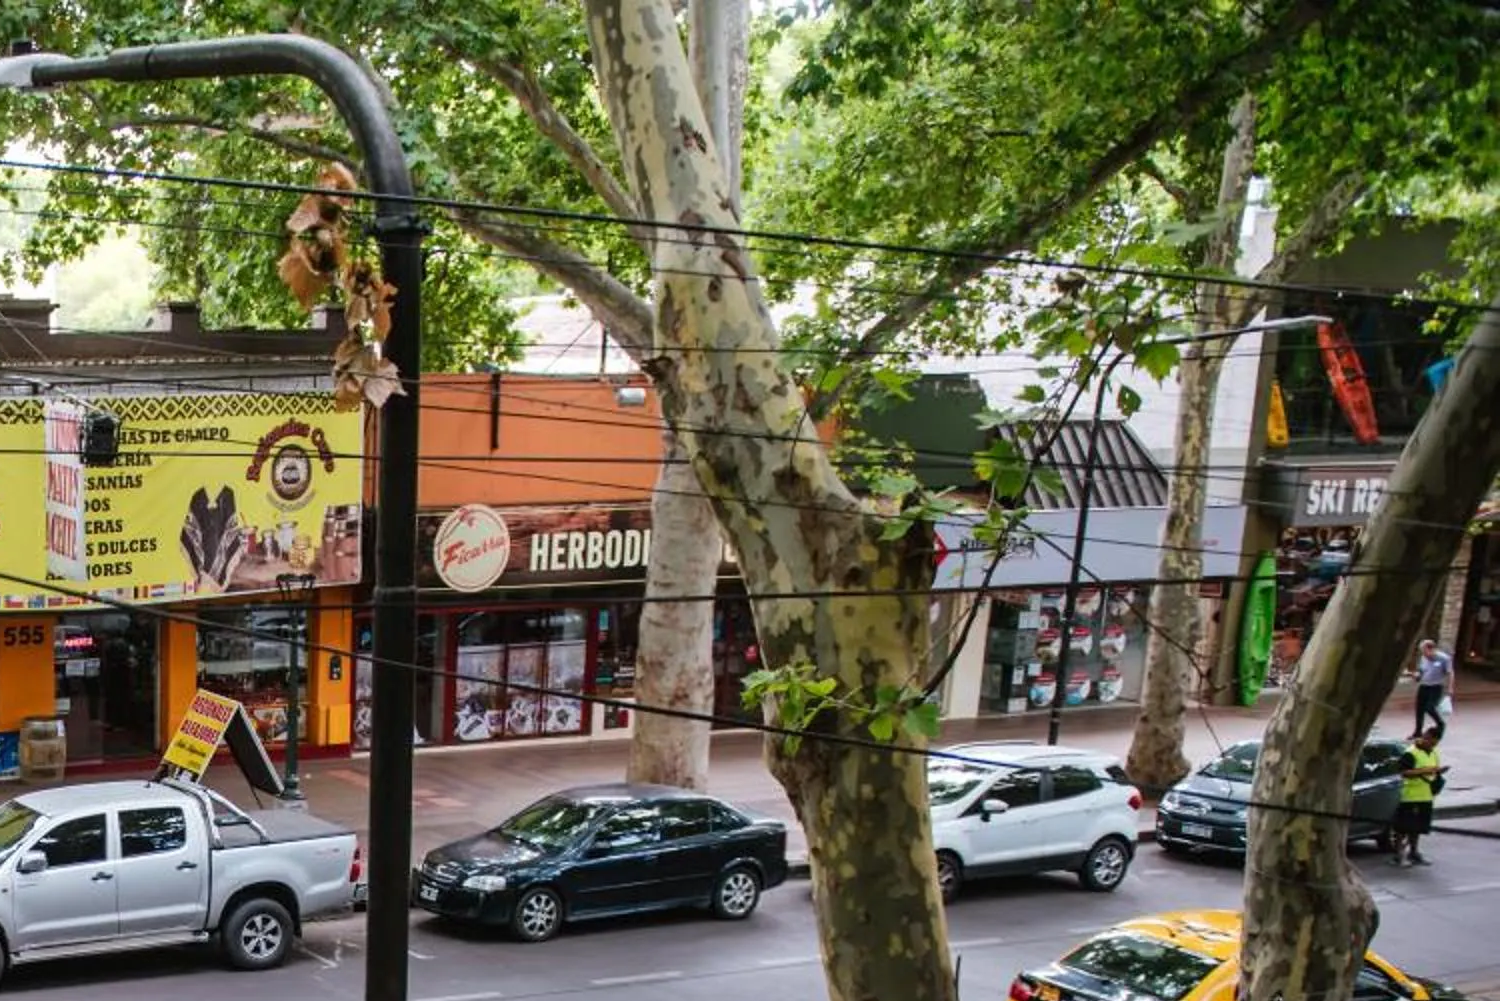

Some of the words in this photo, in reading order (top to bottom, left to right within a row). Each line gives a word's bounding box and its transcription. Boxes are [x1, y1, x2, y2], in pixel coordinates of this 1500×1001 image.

[150, 429, 171, 444] DE
[175, 427, 229, 443] CAMPO
[87, 471, 143, 491] SANÍAS
[1306, 479, 1347, 515] SKI
[97, 538, 158, 556] DULCES
[529, 529, 649, 573] HERBODI
[3, 625, 45, 647] 555
